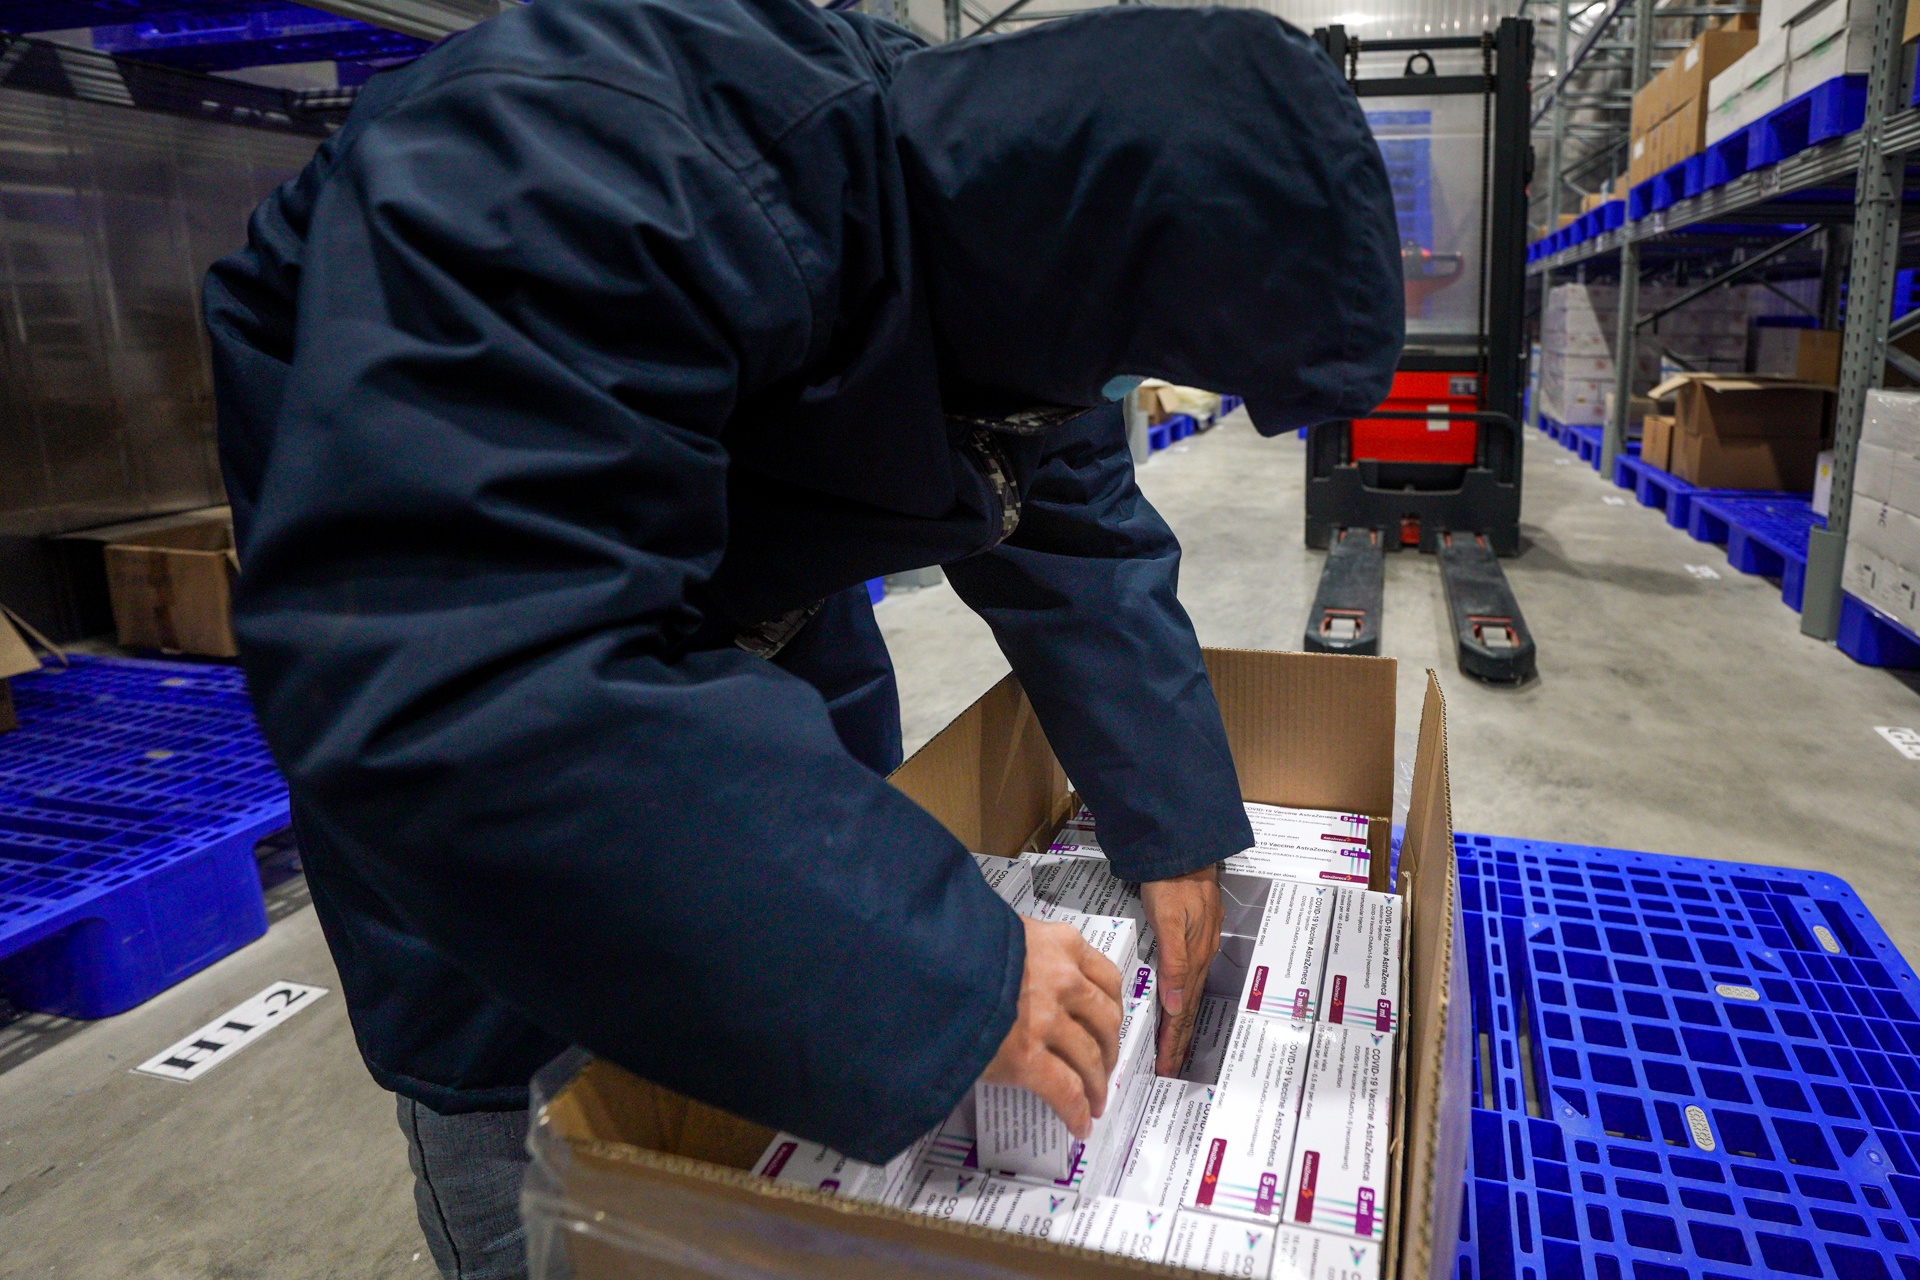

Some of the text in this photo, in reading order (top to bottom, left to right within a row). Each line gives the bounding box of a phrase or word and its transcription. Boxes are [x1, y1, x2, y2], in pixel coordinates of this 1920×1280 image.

[1296, 845, 1336, 853] AstraZeneca
[1043, 866, 1060, 888] COVID-19
[1289, 884, 1297, 907] Intramuscular
[1300, 897, 1322, 984] COVID-19 Vaccine AstraZeneca
[1380, 905, 1392, 995] COVID-19 Vaccine AstraZeneca
[1253, 967, 1262, 991] AstraZeneca
[1296, 997, 1303, 1007] ml
[1379, 1008, 1386, 1017] ml
[160, 988, 308, 1071] H1.2
[1235, 1024, 1243, 1039] doses
[1241, 1024, 1251, 1048] multidose
[1231, 1038, 1239, 1049] per
[1339, 1028, 1348, 1063] Intramuscular
[1224, 1072, 1231, 1080] ml
[1265, 1060, 1273, 1079] Vaccine
[1152, 1088, 1161, 1104] doses
[1220, 1080, 1228, 1091] per
[1278, 1077, 1291, 1108] Vaccine
[1309, 1083, 1316, 1091] ml
[1157, 1088, 1168, 1113] multidose
[1172, 1083, 1187, 1118] Intramuscular
[1183, 1100, 1194, 1124] COVID-19
[1194, 1101, 1203, 1122] solution
[1362, 1048, 1380, 1180] COVID-19 Vaccine AstraZeneca
[1136, 1139, 1144, 1147] ml
[1177, 1125, 1187, 1145] Vaccine
[1185, 1131, 1195, 1154] injection
[1266, 1111, 1284, 1166] AstraZeneca
[1126, 1159, 1136, 1176] dose)
[1205, 1140, 1219, 1176] AstraZeneca
[1302, 1153, 1312, 1190] AstraZeneca
[1259, 1175, 1274, 1199] 5 ml
[1359, 1190, 1372, 1215] 5 ml
